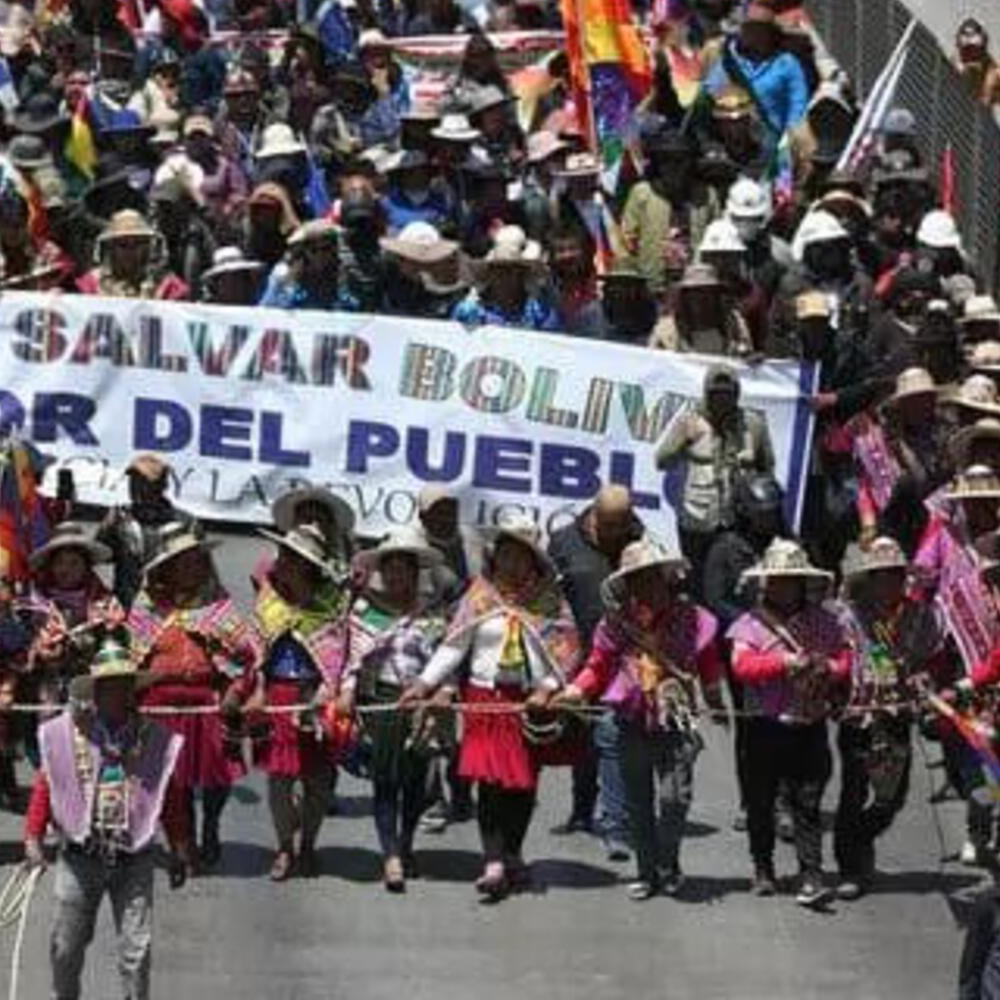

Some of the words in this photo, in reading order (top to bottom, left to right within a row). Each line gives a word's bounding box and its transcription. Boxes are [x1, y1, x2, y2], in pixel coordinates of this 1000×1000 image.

[11, 307, 372, 391] SALVAR
[398, 342, 690, 444] BOLIV
[133, 395, 311, 468] DEL
[346, 418, 689, 511] PUEBL
